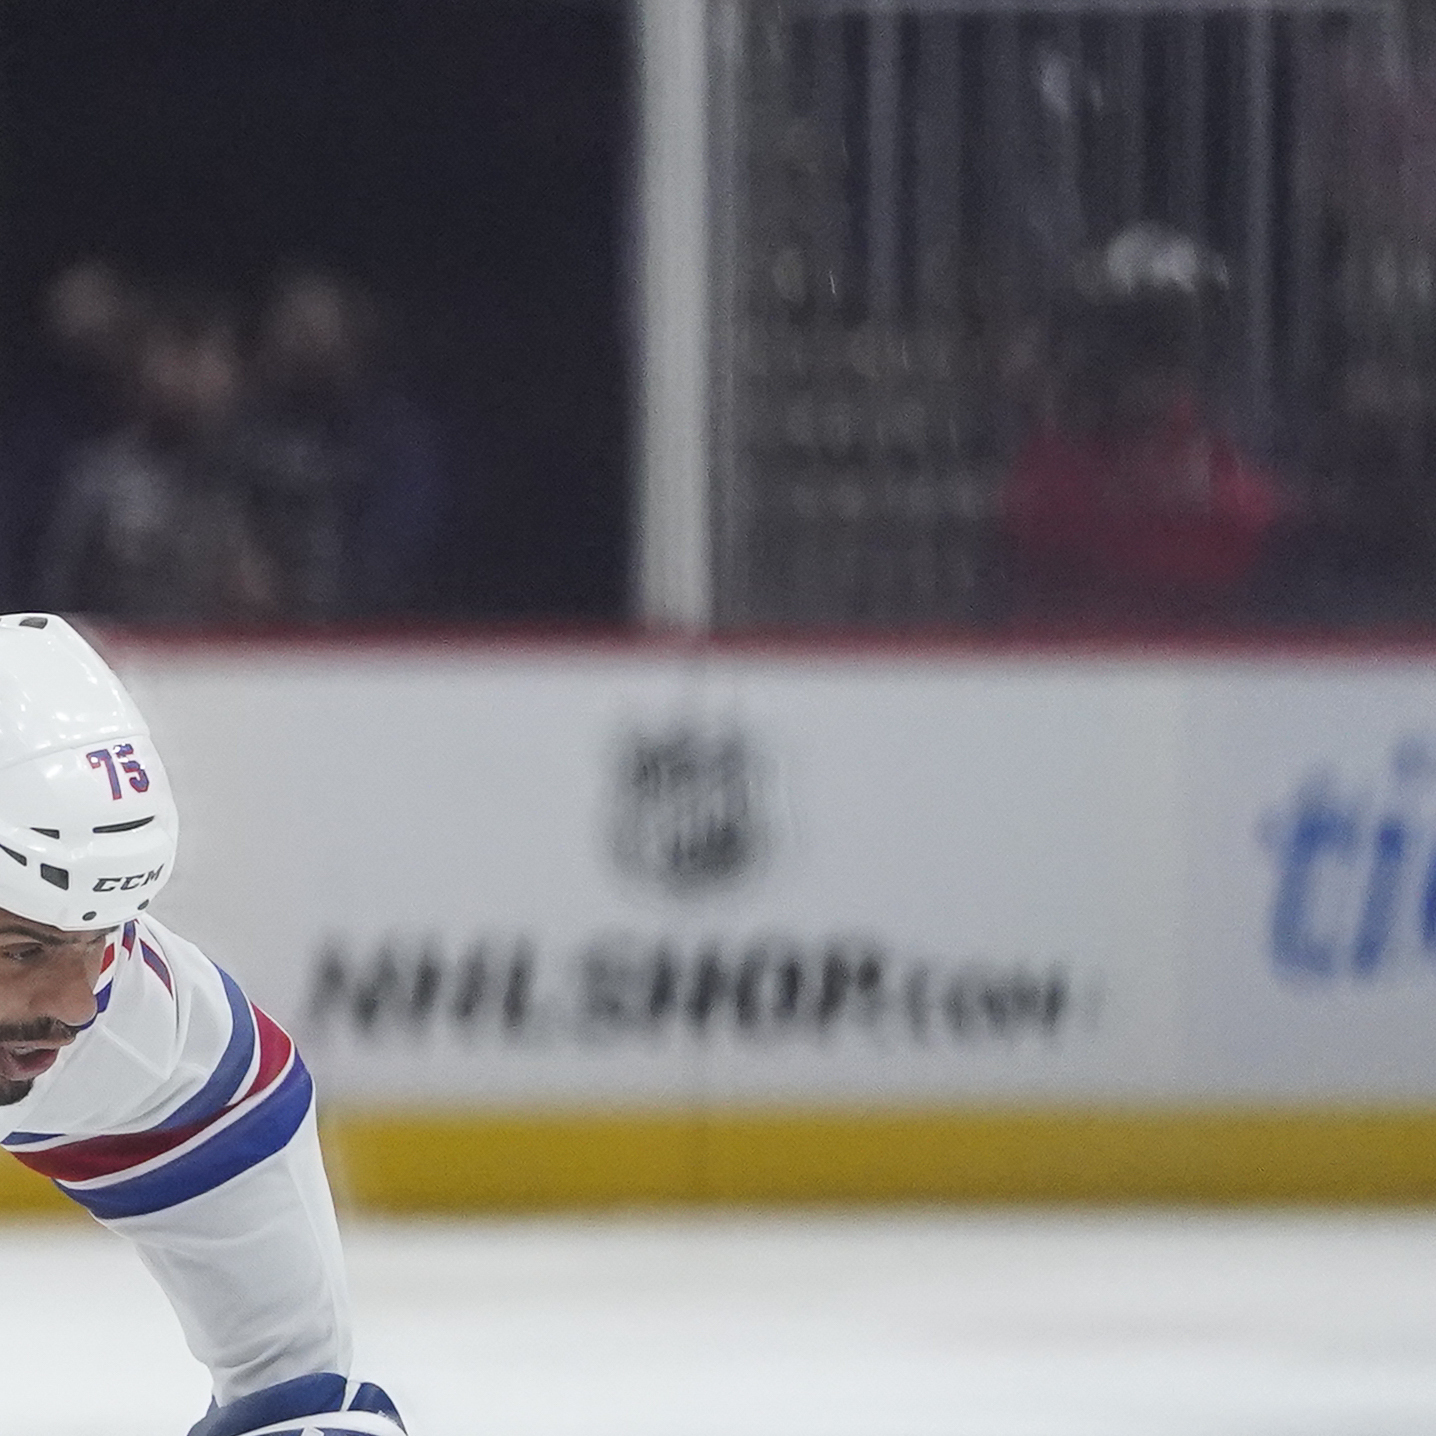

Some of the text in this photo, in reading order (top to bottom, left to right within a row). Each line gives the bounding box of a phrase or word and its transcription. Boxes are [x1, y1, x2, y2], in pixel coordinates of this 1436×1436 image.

[85, 743, 150, 800] 75
[92, 863, 165, 892] CCM
[1253, 735, 1436, 982] ti
